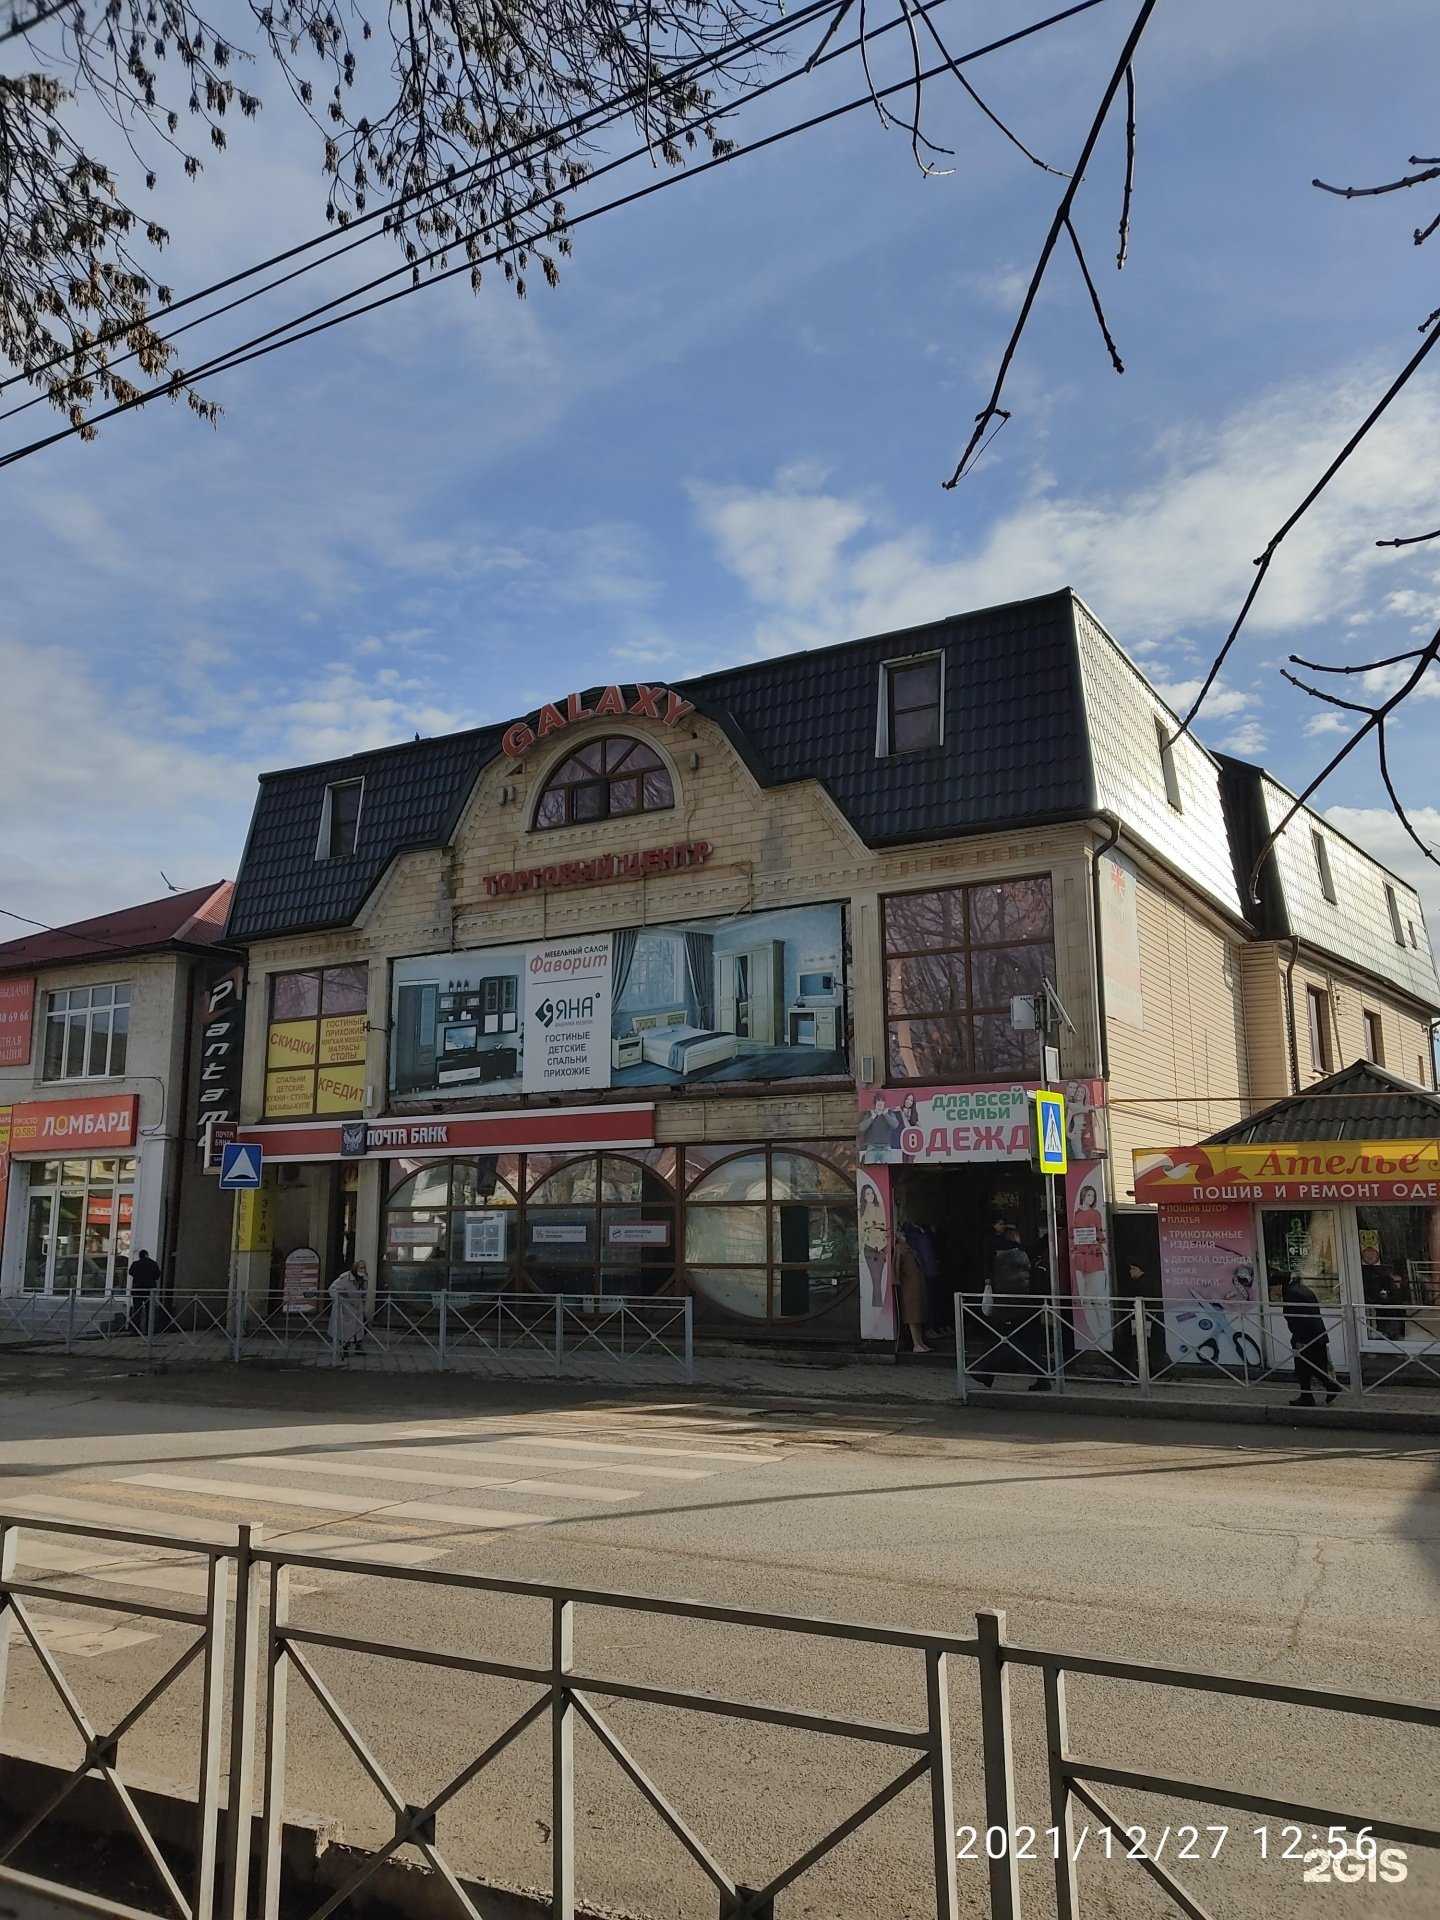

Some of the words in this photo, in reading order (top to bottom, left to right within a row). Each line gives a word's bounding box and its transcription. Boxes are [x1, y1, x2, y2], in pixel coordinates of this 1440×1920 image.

[502, 683, 696, 757] GALAXY
[482, 853, 624, 896] ТОРГОВЫЙ
[624, 840, 713, 873] ЦЕНТР
[544, 946, 583, 958] МЕБЕЛЬНЫЙ
[584, 944, 609, 954] САЛОН
[530, 954, 608, 975] Фаворит
[556, 997, 594, 1019] ЯНА
[325, 1027, 364, 1037] ПРИХОЖИЕ
[545, 1031, 590, 1042] ГОСТИНЫЕ
[271, 1033, 315, 1055] СКИДКИ
[328, 1044, 360, 1053] МАТРАСЫ
[548, 1043, 586, 1055] ДЕТСКИЕ
[197, 979, 233, 1147] Pantam
[547, 1055, 587, 1066] СПАЛЬНИ
[544, 1067, 590, 1078] ПРИХОЖИЕ
[319, 1078, 365, 1102] КРЕДИТ
[42, 1111, 130, 1136] ЛОМБАРД
[215, 1130, 234, 1138] ПОЧТА
[366, 1128, 408, 1146] ПОЧТА
[410, 1126, 448, 1145] БАНК
[1255, 1149, 1422, 1176] Ателье
[1193, 1185, 1264, 1200] ПОШИВ
[1275, 1184, 1287, 1199] И
[1300, 1183, 1380, 1198] РЕМОНТ
[1202, 1203, 1229, 1213] ШТОР
[1168, 1230, 1245, 1239] ТРИКОТАЖНЫЕ
[1170, 1240, 1216, 1249] ИЗДЕЛИЯ
